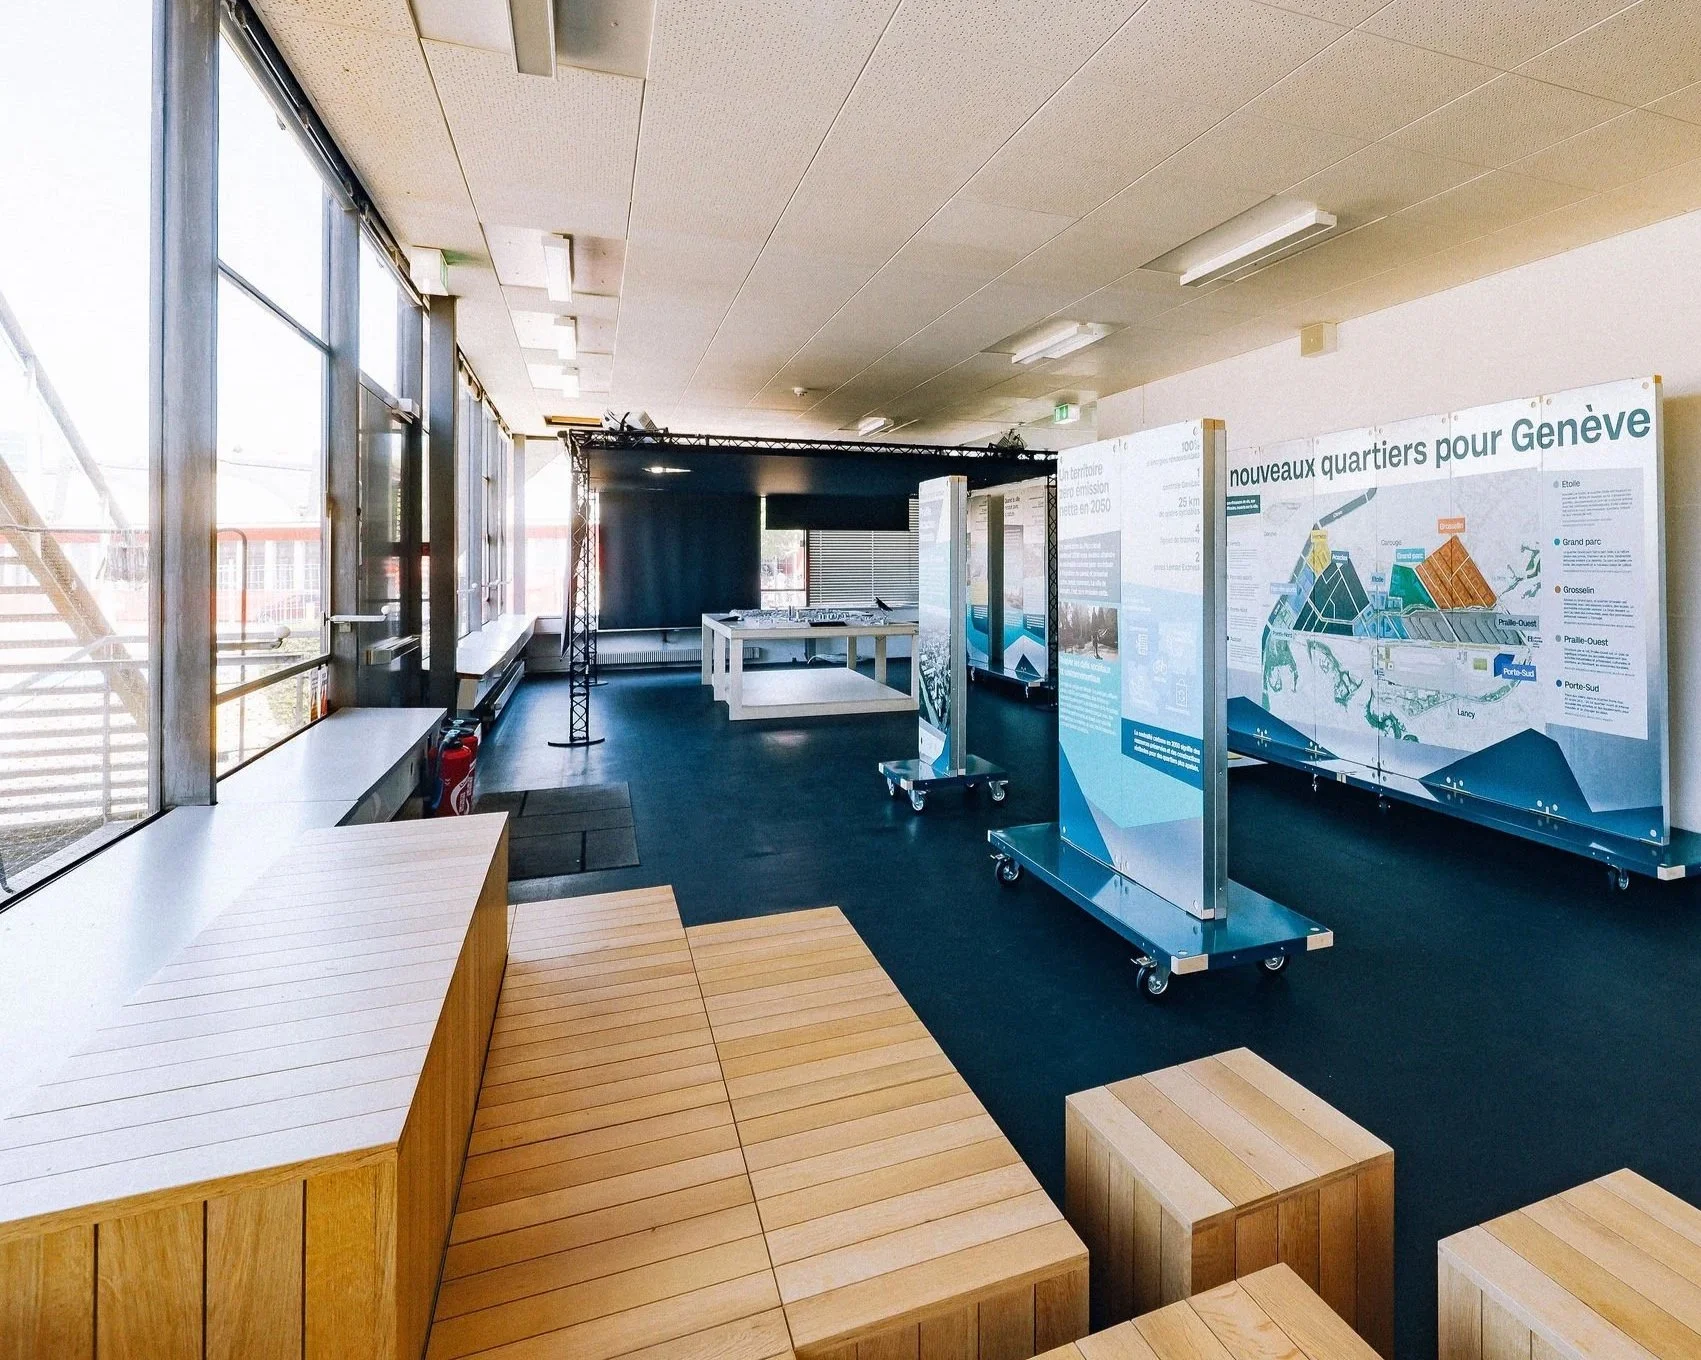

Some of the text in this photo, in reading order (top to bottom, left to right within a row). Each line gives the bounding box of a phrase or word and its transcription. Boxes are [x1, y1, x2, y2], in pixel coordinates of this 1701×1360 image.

[1230, 404, 1651, 487] nouveaux quartiers pour Genève
[1070, 462, 1103, 480] territoire
[1075, 481, 1110, 497] émission
[1060, 503, 1078, 517] nette
[1080, 502, 1089, 515] en
[1091, 498, 1111, 514] 2050
[1178, 496, 1200, 508] 25 km
[1562, 538, 1602, 547] Grand parc
[1195, 551, 1200, 563] 2
[1563, 585, 1595, 595] Grosselin
[1498, 618, 1537, 628] Praille-Ouest
[1564, 635, 1609, 647] Praille-Ouest
[1503, 667, 1535, 678] Porte-Sud
[1564, 680, 1600, 693] Porte-Sud
[1457, 708, 1475, 719] Lancy
